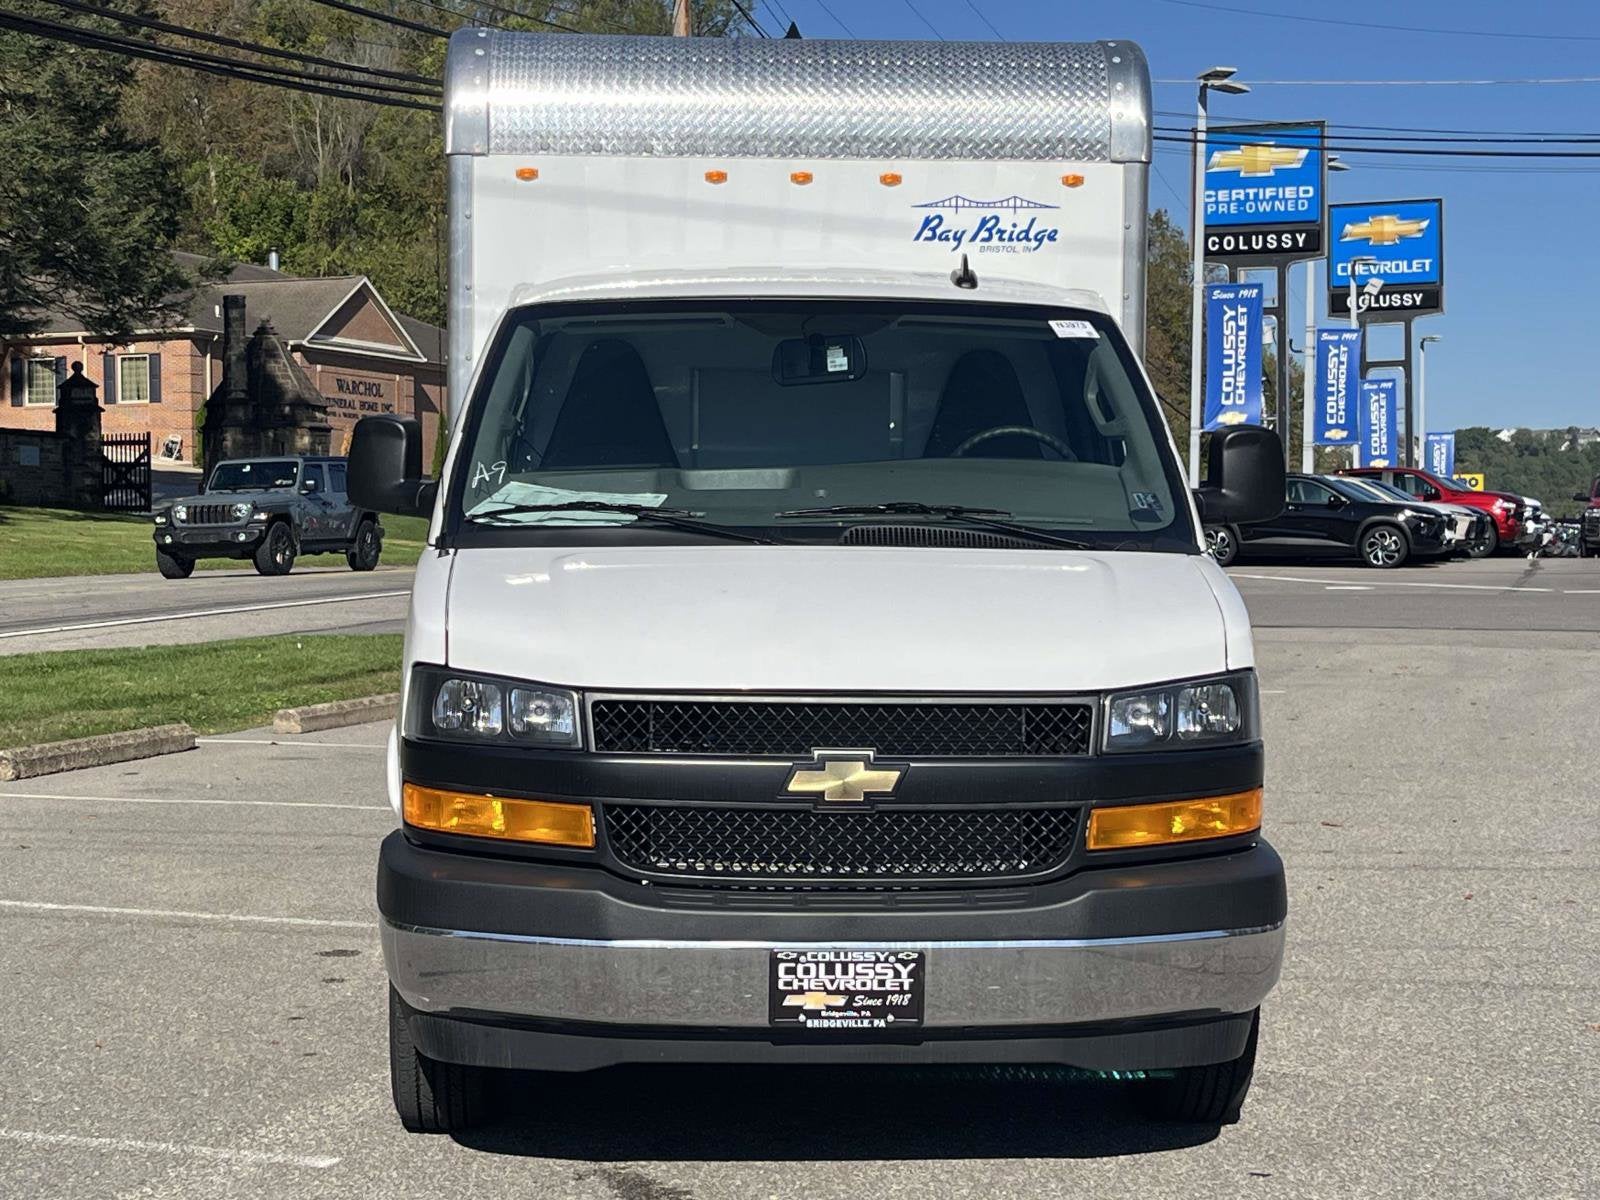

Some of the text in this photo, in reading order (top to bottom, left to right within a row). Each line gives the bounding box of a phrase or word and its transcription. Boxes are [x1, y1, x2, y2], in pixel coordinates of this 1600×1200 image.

[1205, 186, 1314, 203] CERTIFIED
[1207, 199, 1309, 215] PRE-OWNED
[913, 214, 1059, 252] Bay Bridge
[1023, 245, 1032, 253] IN
[1207, 233, 1306, 251] COLUSSY
[1337, 259, 1432, 276] CHEVROLET
[1212, 289, 1259, 300] Since 1918
[1221, 305, 1236, 405] COLUSSY
[1235, 304, 1248, 405] CHEVROLET
[336, 378, 384, 398] WARCHOL
[1326, 345, 1339, 425] COLUSSY
[1338, 345, 1349, 425] CHEVROLET
[1370, 392, 1380, 456] COLUSSY
[807, 952, 890, 962] COLUSSY
[778, 962, 916, 980] COLUSSY
[778, 978, 914, 991] CHEVROLET
[852, 993, 912, 1007] Since 1918
[873, 1019, 886, 1028] PA
